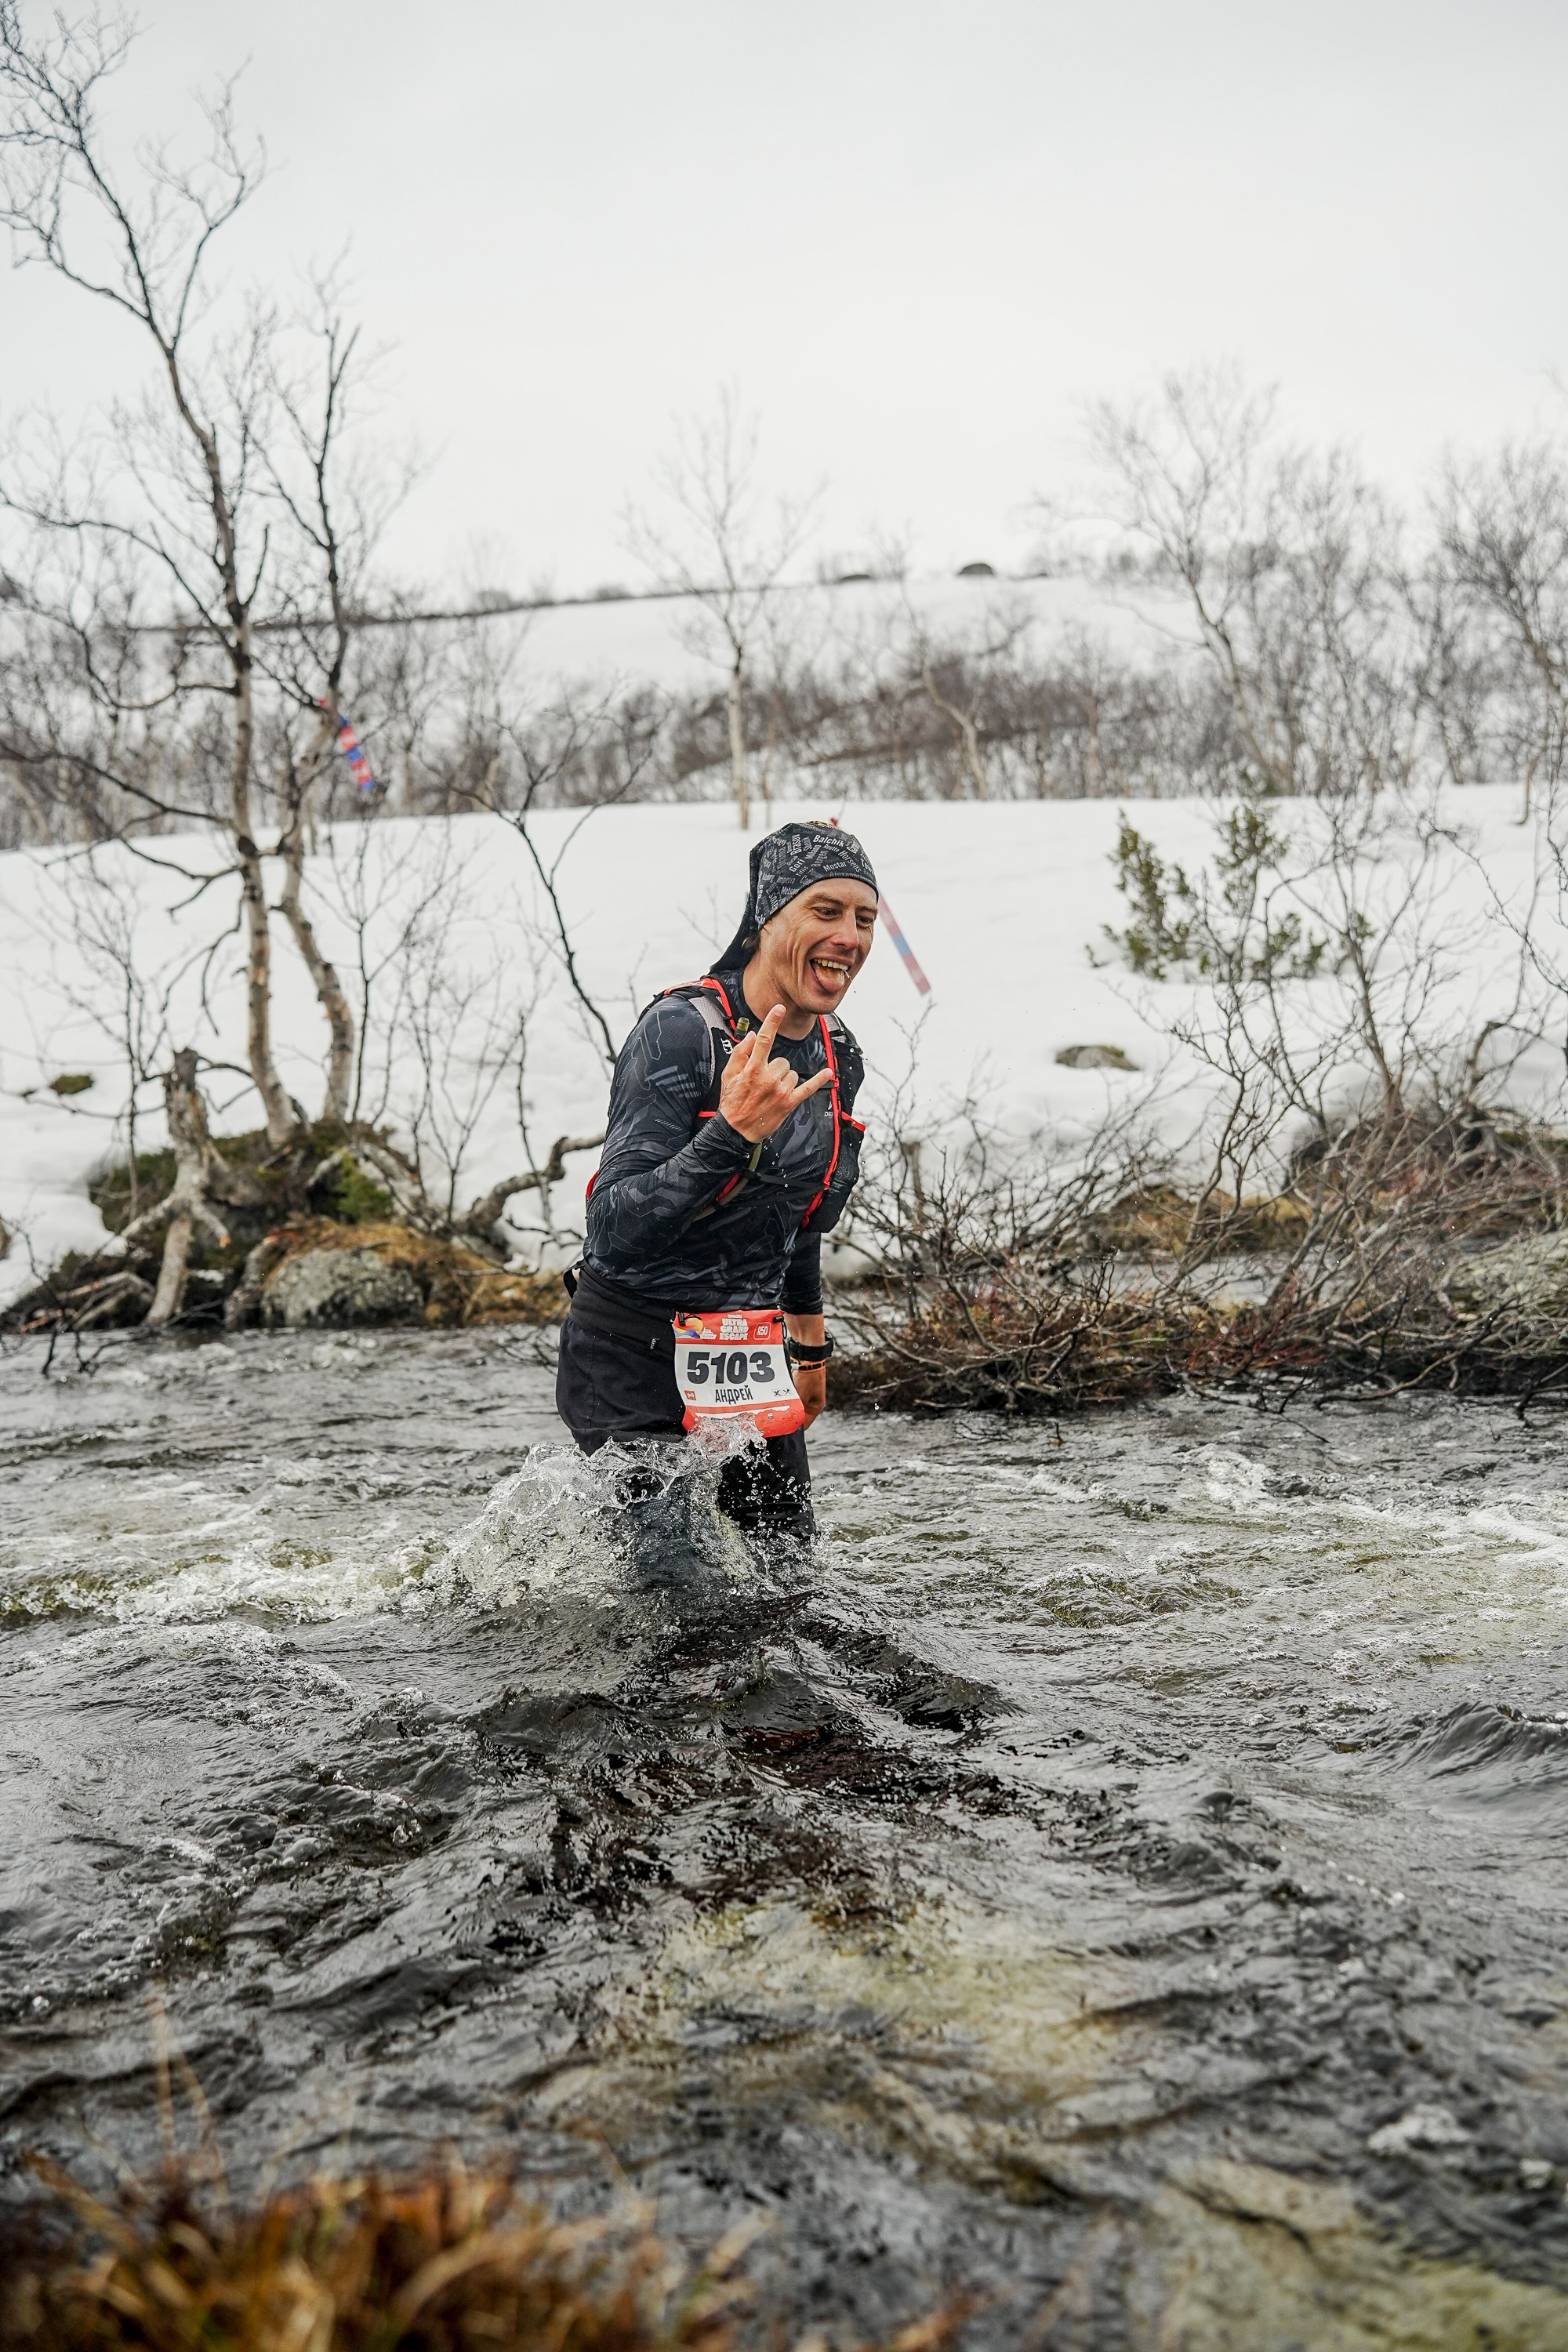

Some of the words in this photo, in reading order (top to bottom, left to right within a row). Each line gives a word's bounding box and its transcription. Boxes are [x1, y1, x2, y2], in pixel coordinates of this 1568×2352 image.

[812, 834, 845, 848] Balchik
[789, 858, 805, 873] Gori
[811, 850, 829, 867] Bergen
[823, 861, 848, 872] Mostar
[837, 850, 862, 873] Horsens
[757, 1326, 768, 1336] R50
[687, 1351, 775, 1385] 5103
[715, 1385, 753, 1405] АНДРЕЙ
